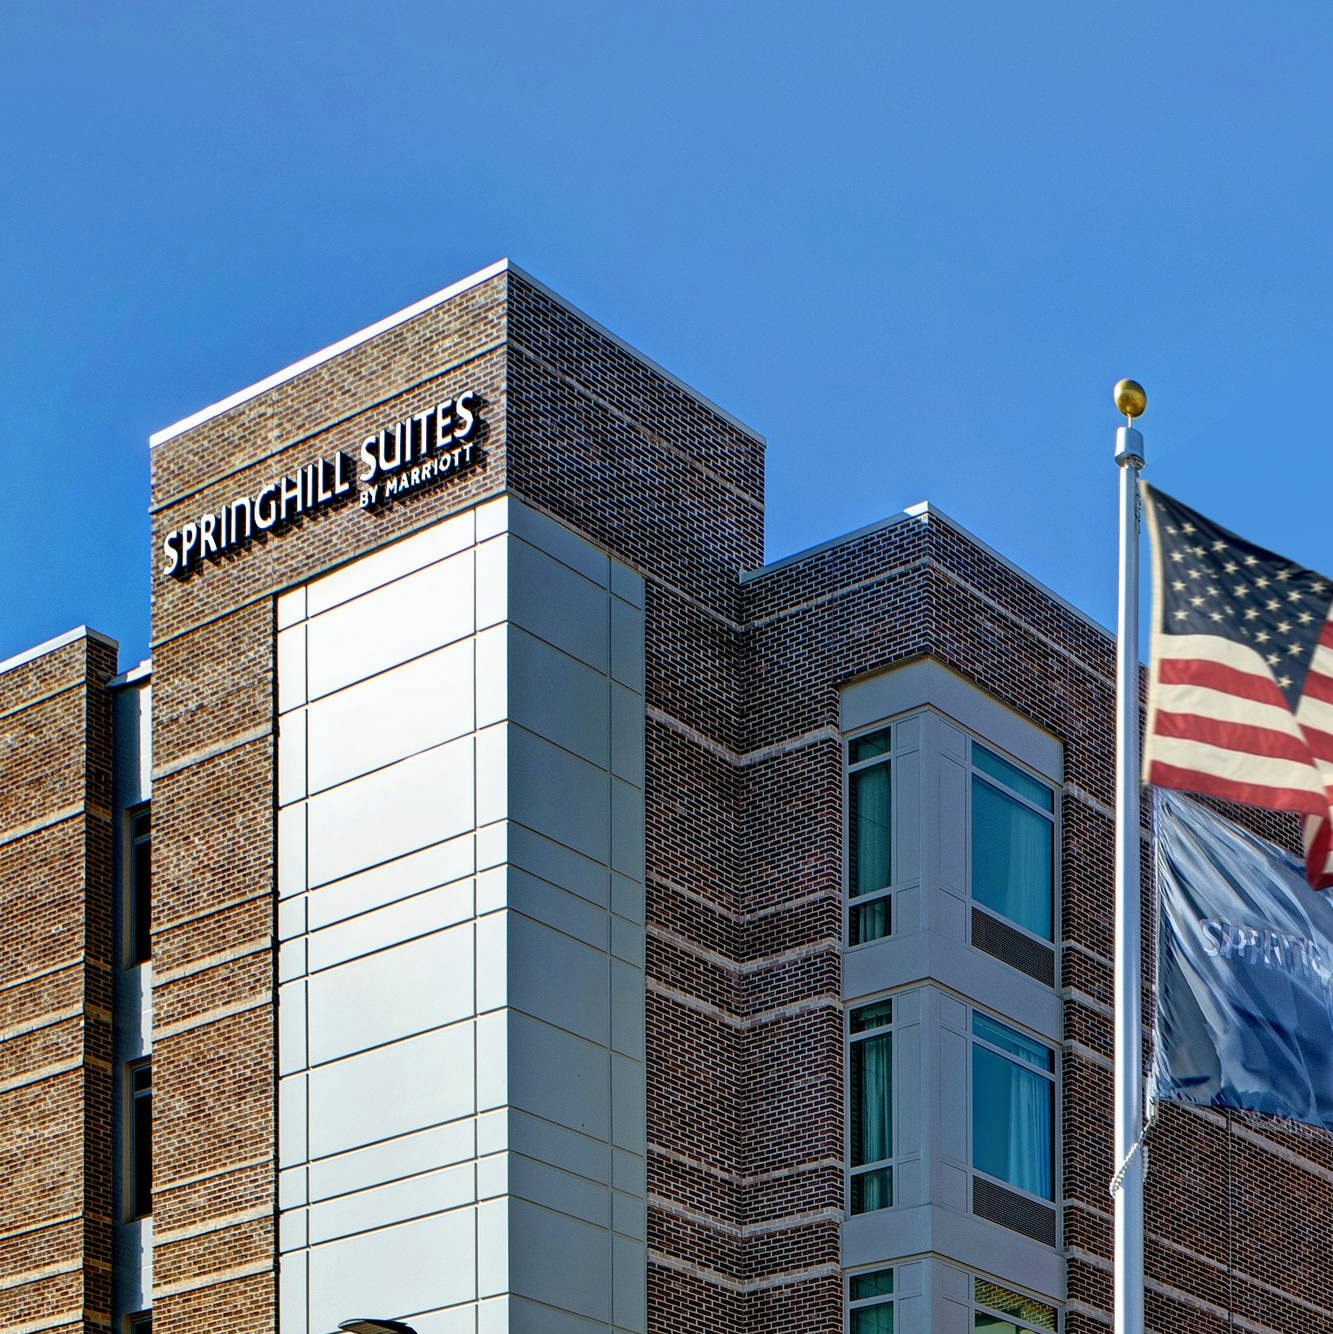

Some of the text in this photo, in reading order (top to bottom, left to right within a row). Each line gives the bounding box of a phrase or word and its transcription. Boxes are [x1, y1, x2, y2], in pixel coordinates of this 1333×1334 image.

[163, 390, 474, 576] SPRINGHILL SUITES
[360, 443, 474, 508] BY MARRIOTT
